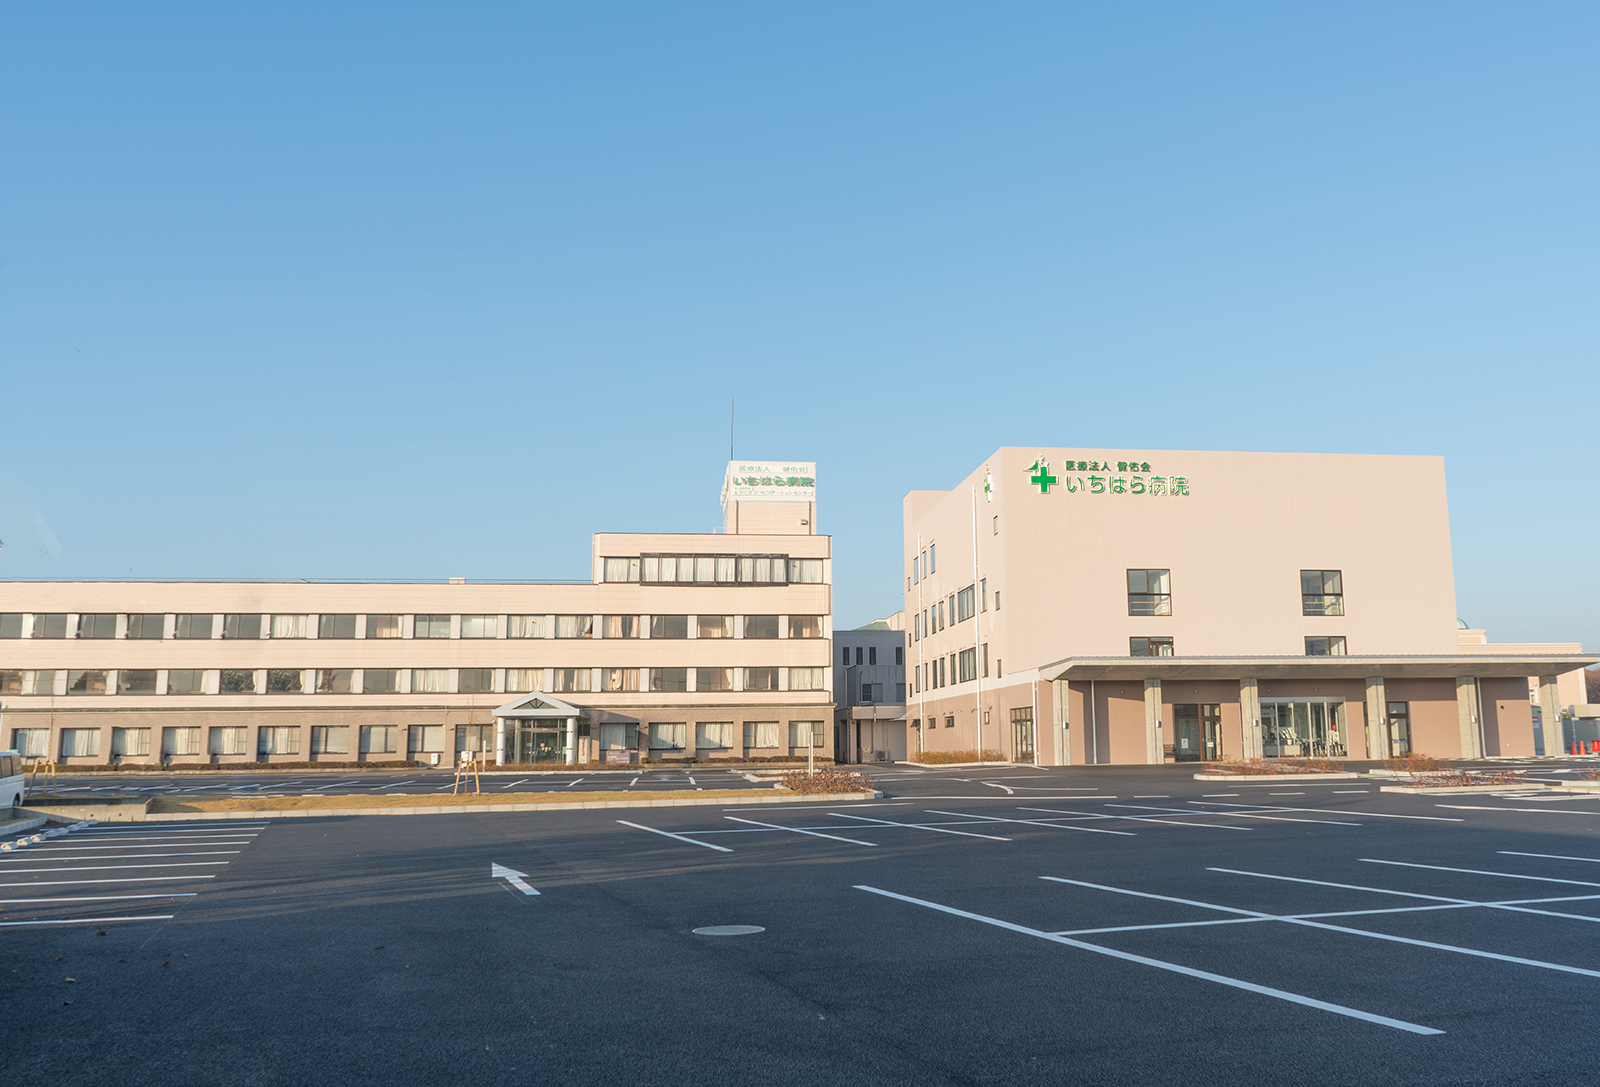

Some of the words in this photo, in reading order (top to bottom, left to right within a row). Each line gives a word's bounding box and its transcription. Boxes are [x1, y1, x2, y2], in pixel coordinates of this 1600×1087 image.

[1065, 460, 1111, 471] 医療法人
[1117, 461, 1151, 472] 健佑会
[732, 476, 814, 486] いちはら病院
[1065, 475, 1189, 496] いちはら病院
